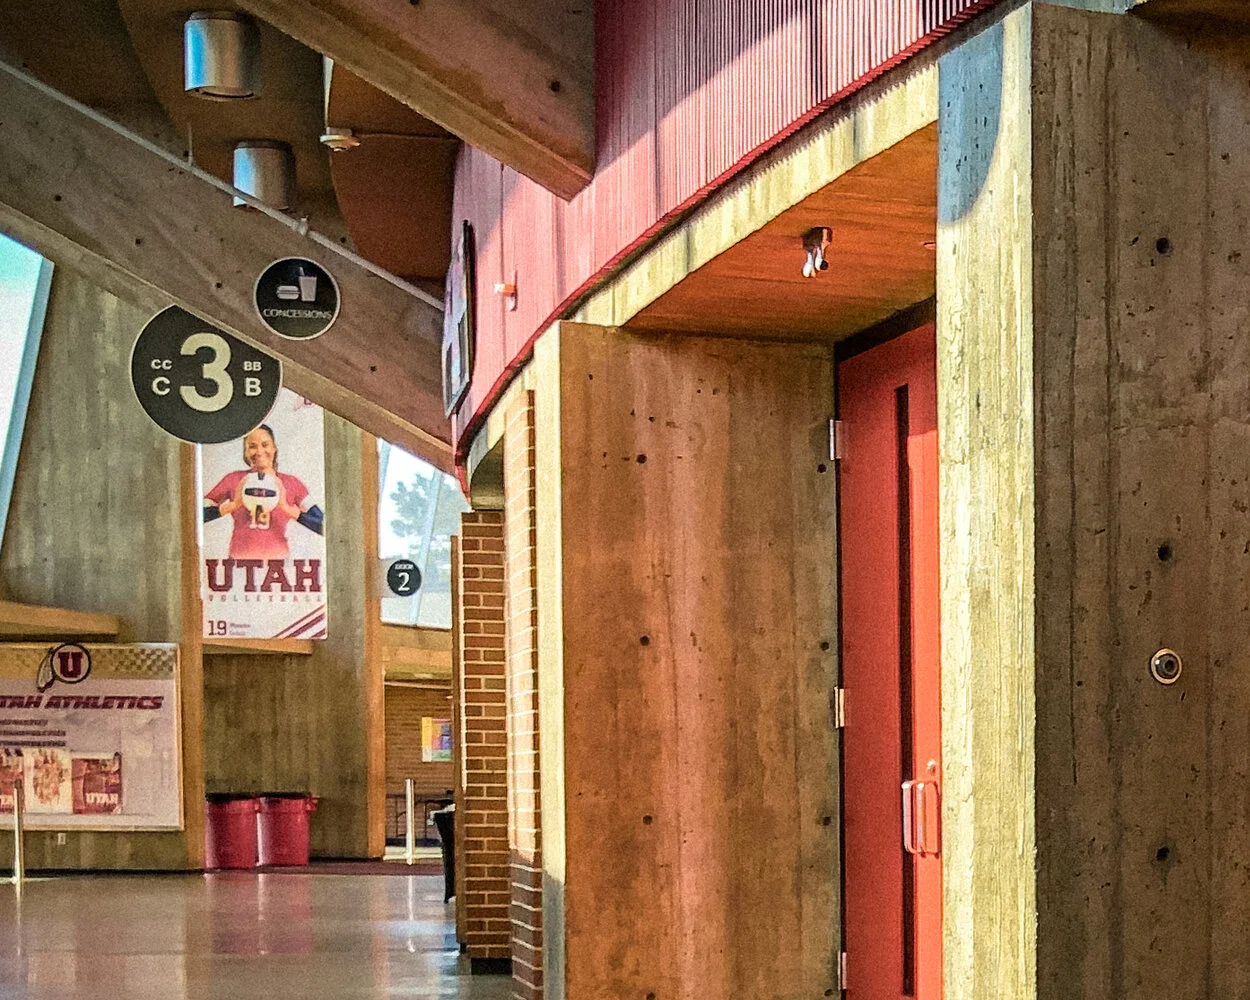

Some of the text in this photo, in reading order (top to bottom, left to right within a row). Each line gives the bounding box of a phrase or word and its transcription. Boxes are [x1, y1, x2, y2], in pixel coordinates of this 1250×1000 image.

[150, 359, 173, 370] CC
[180, 332, 234, 412] 3
[243, 361, 262, 371] BB
[152, 376, 171, 396] C
[244, 377, 262, 396] B
[205, 559, 322, 593] UTAH
[398, 572, 410, 591] 2
[208, 620, 227, 636] 19
[58, 652, 83, 678] U
[45, 695, 164, 709] ATHLETICS
